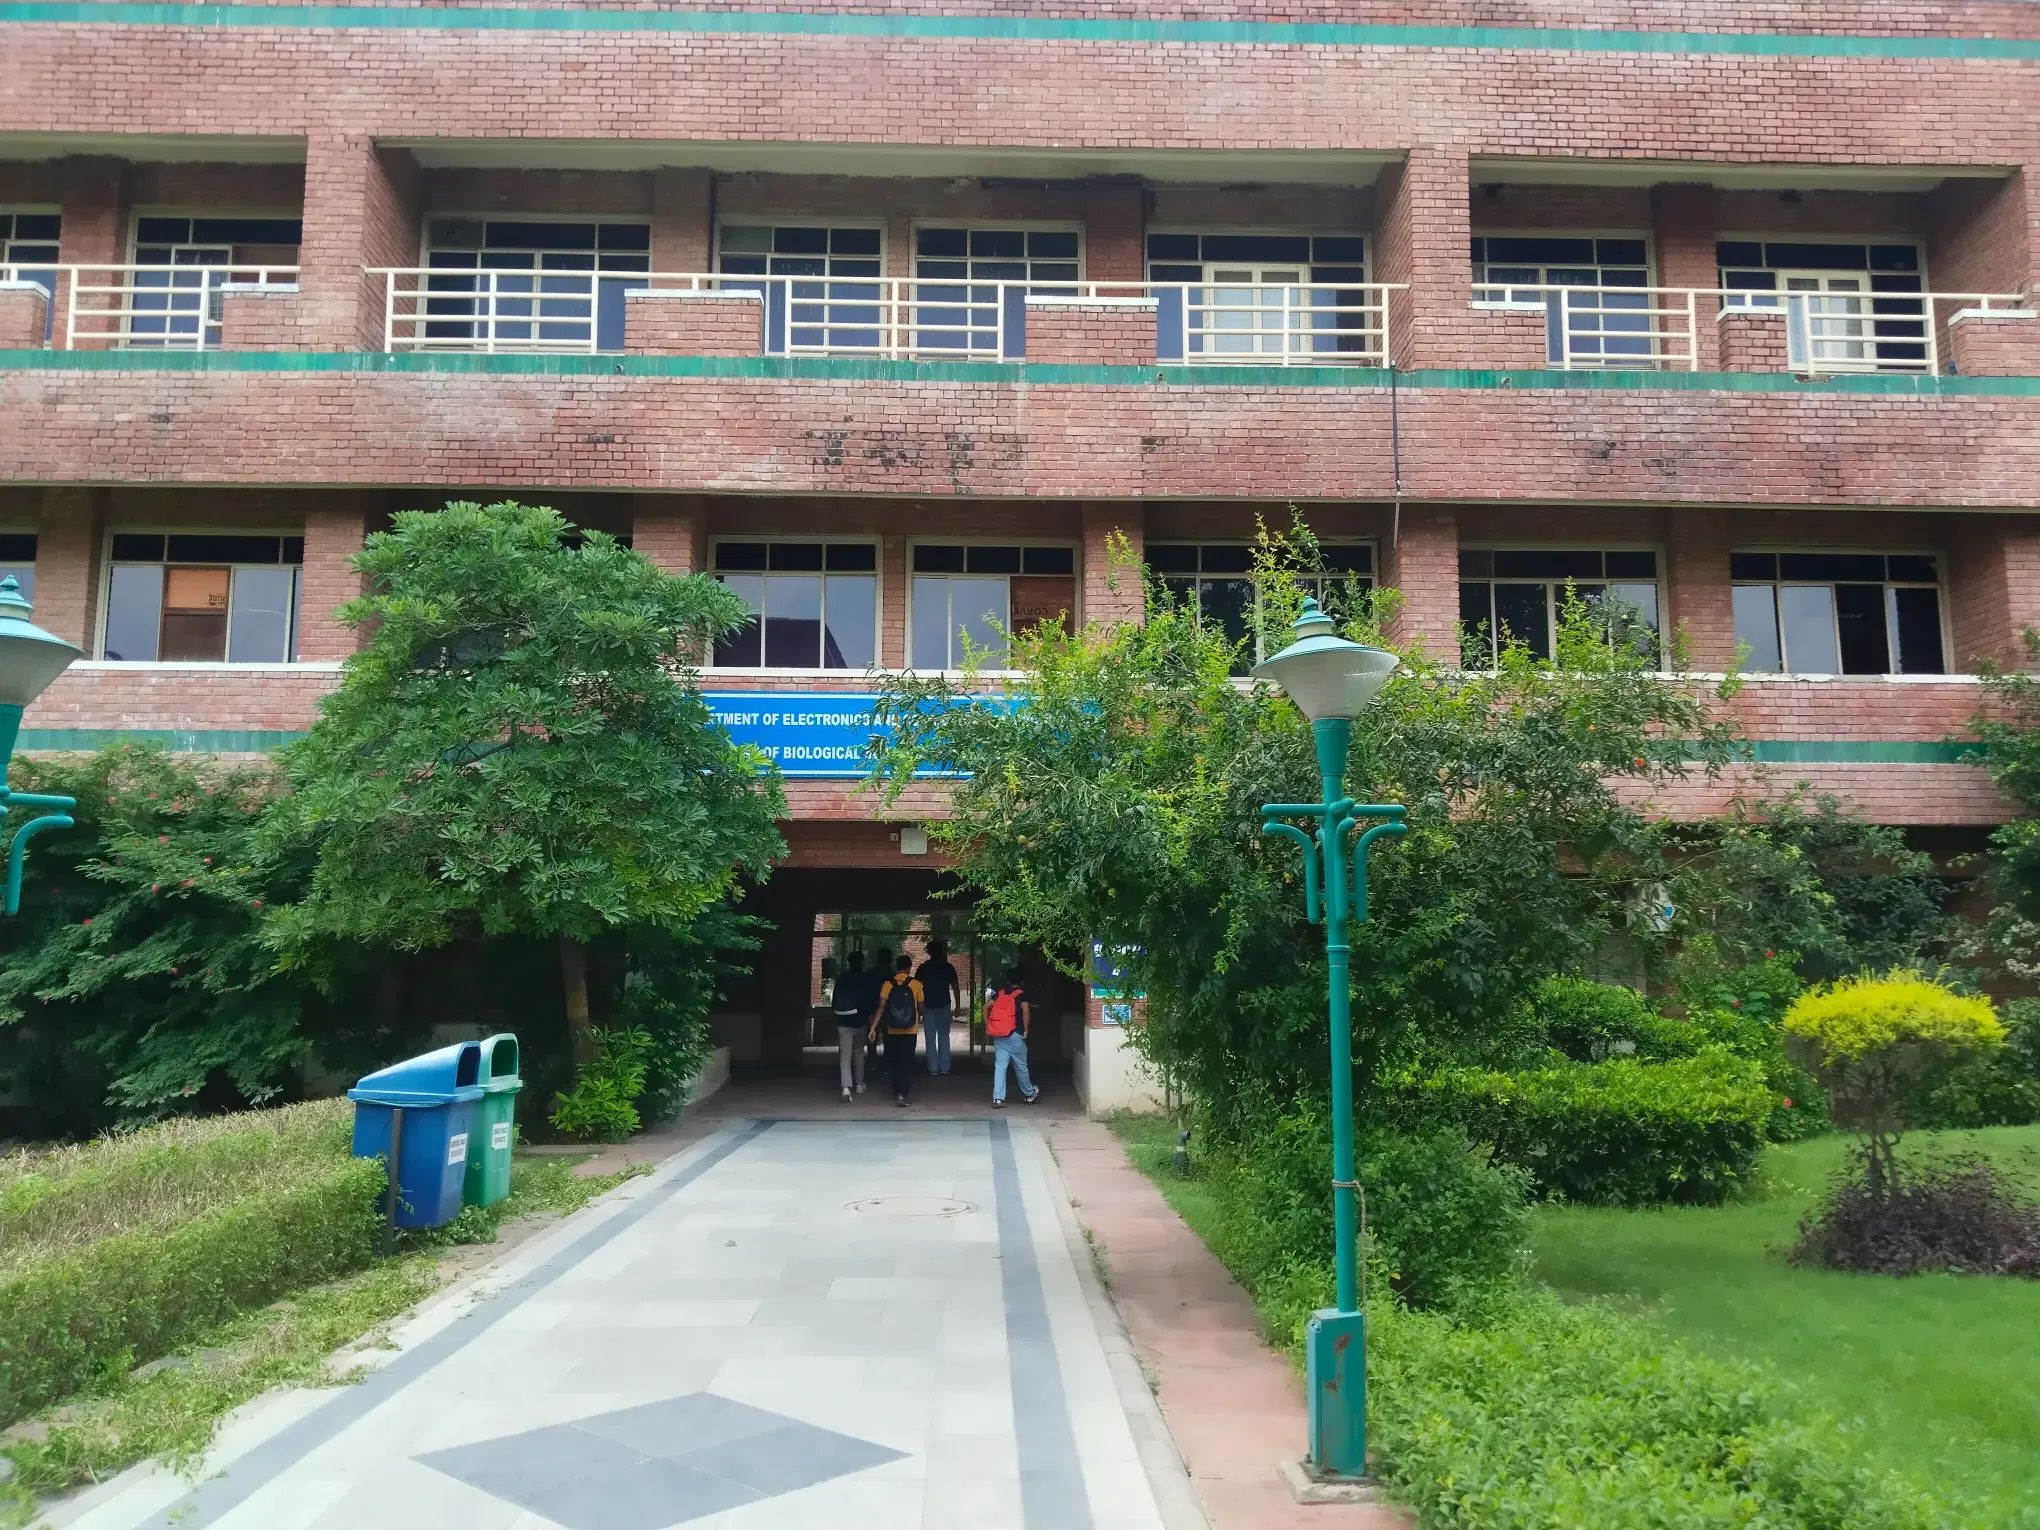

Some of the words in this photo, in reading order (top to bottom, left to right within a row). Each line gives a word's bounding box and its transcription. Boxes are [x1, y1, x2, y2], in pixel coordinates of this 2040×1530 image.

[704, 713, 759, 725] RTMENT
[763, 713, 779, 725] OF
[783, 713, 870, 726] ELECTRONICS
[764, 747, 779, 759] OF
[783, 746, 861, 760] BIOLOGICAL
